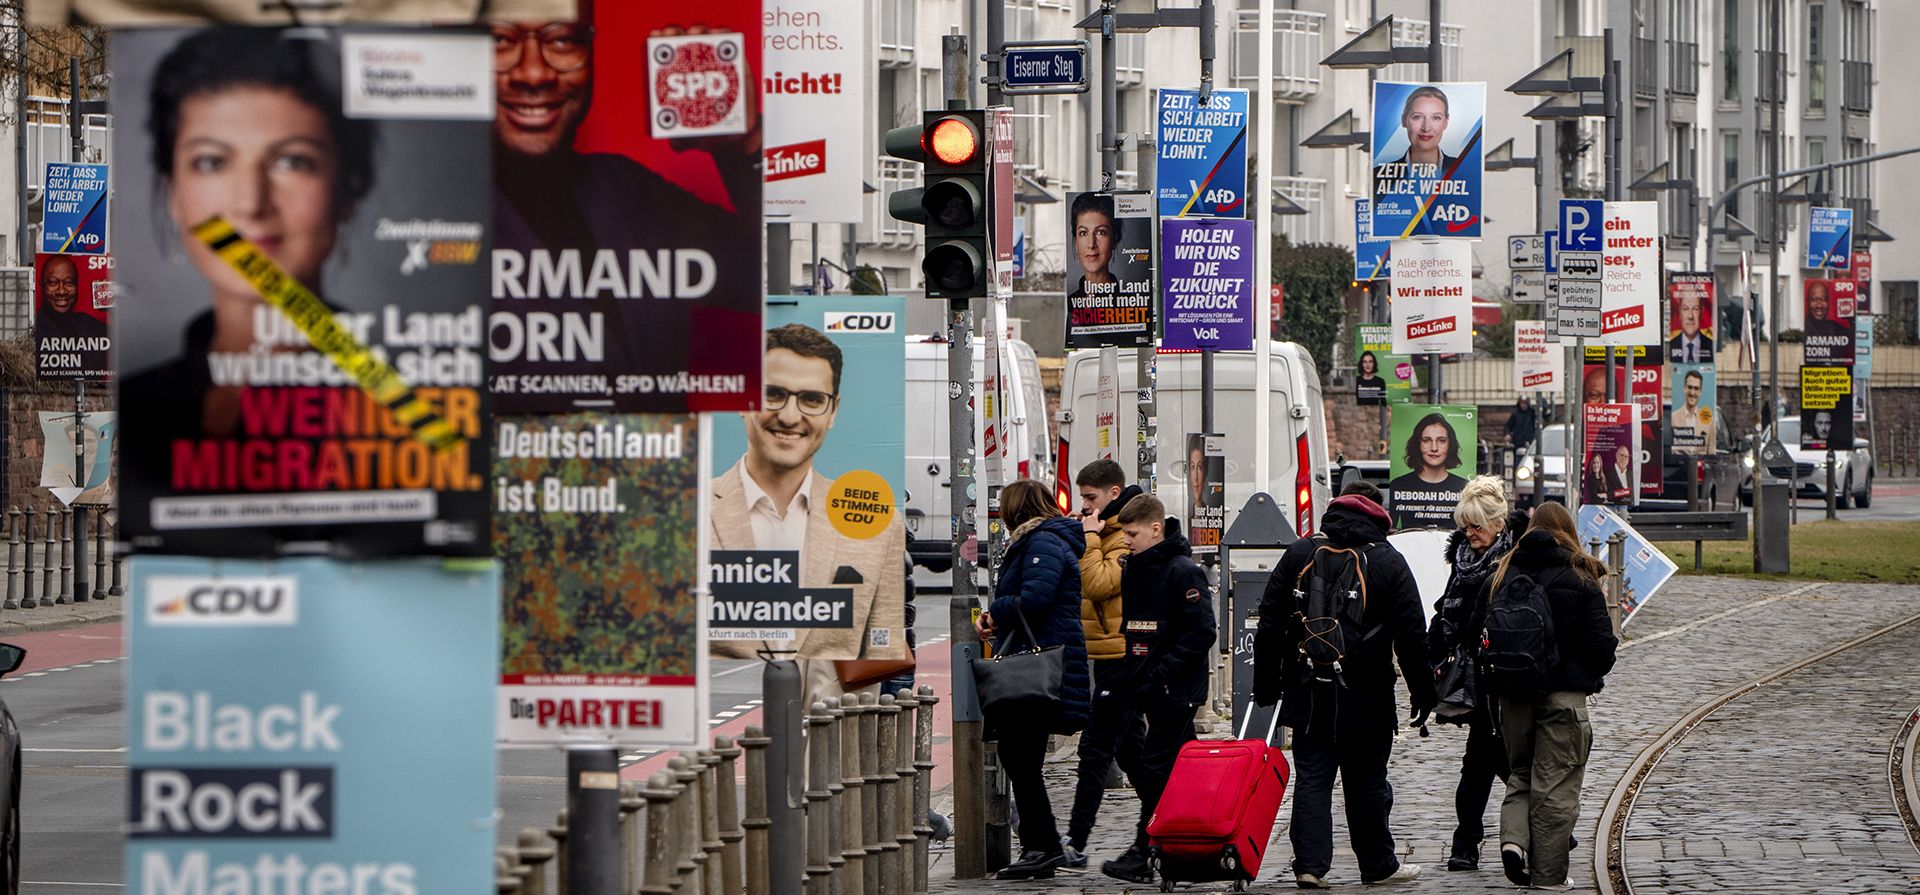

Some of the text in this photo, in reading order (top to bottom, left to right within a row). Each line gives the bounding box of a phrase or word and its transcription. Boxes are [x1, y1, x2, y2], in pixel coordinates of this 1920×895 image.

[1013, 54, 1074, 82] Eiserner Steg
[665, 70, 728, 100] SPD
[1163, 94, 1194, 111] ZEIT,
[1162, 110, 1243, 127] SICH ARBEIT
[1163, 128, 1213, 143] WIEDER
[1162, 144, 1208, 159] LOHNT.
[49, 166, 97, 179] ZEIT, DASS
[1377, 163, 1438, 179] ZEIT FÜR
[48, 178, 105, 191] SICH ARBEIT
[1377, 180, 1469, 196] ALICE WEIDEL
[48, 190, 84, 202] WIEDER
[1204, 189, 1236, 203] AfD
[47, 202, 80, 213] LOHNT.
[1432, 203, 1470, 221] AfD
[77, 233, 99, 244] AfD
[1180, 229, 1234, 243] HOLEN
[1607, 235, 1654, 248] unter
[1174, 245, 1241, 260] WIR UNS
[1829, 254, 1845, 263] AfD
[88, 256, 116, 270] SPD
[1193, 262, 1220, 276] DIE
[1397, 258, 1453, 270] Alle gehen
[1397, 268, 1464, 279] nach rechts.
[1606, 270, 1642, 280] Reiche
[1084, 280, 1150, 294] Unser Land
[1169, 278, 1245, 293] ZUKUNFT
[1397, 286, 1463, 297] Wir nicht!
[1562, 286, 1598, 296] gebühren-
[1604, 282, 1636, 293] Yacht.
[1835, 282, 1854, 292] SPD
[1071, 294, 1150, 309] verdient mehr
[1173, 292, 1239, 309] ZURÜCK
[1565, 295, 1594, 304] pflichtig
[1071, 307, 1150, 324] SICHERHEIT.
[1605, 313, 1640, 330] Linke
[383, 304, 483, 347] Land
[843, 315, 893, 331] CDU
[1410, 321, 1453, 337] Die Linke
[1560, 317, 1598, 329] max 15 min
[1193, 327, 1220, 340] Volt
[1518, 328, 1529, 336] Ist
[40, 337, 111, 351] ARMAND
[1806, 335, 1849, 346] ARMAND
[1806, 347, 1831, 357] ZORN
[40, 353, 81, 368] ZORN
[395, 345, 483, 387] sich
[488, 371, 746, 397] AT SCANNEN, SPD WÄHLEN!
[499, 423, 683, 461] Deutschland
[171, 439, 484, 492] MIGRATION.
[498, 477, 627, 514] ist Bund.
[843, 488, 880, 502] BEIDE
[1394, 491, 1437, 501] DEBORAH
[831, 498, 890, 515] STIMMEN
[843, 512, 875, 525] CDU
[188, 586, 282, 616] CDU
[733, 629, 757, 639] nach
[758, 629, 789, 639] Berlin
[510, 698, 663, 729] Die PARTEI
[142, 691, 343, 752] Black
[141, 769, 326, 832] Rock
[141, 851, 417, 895] Matters
